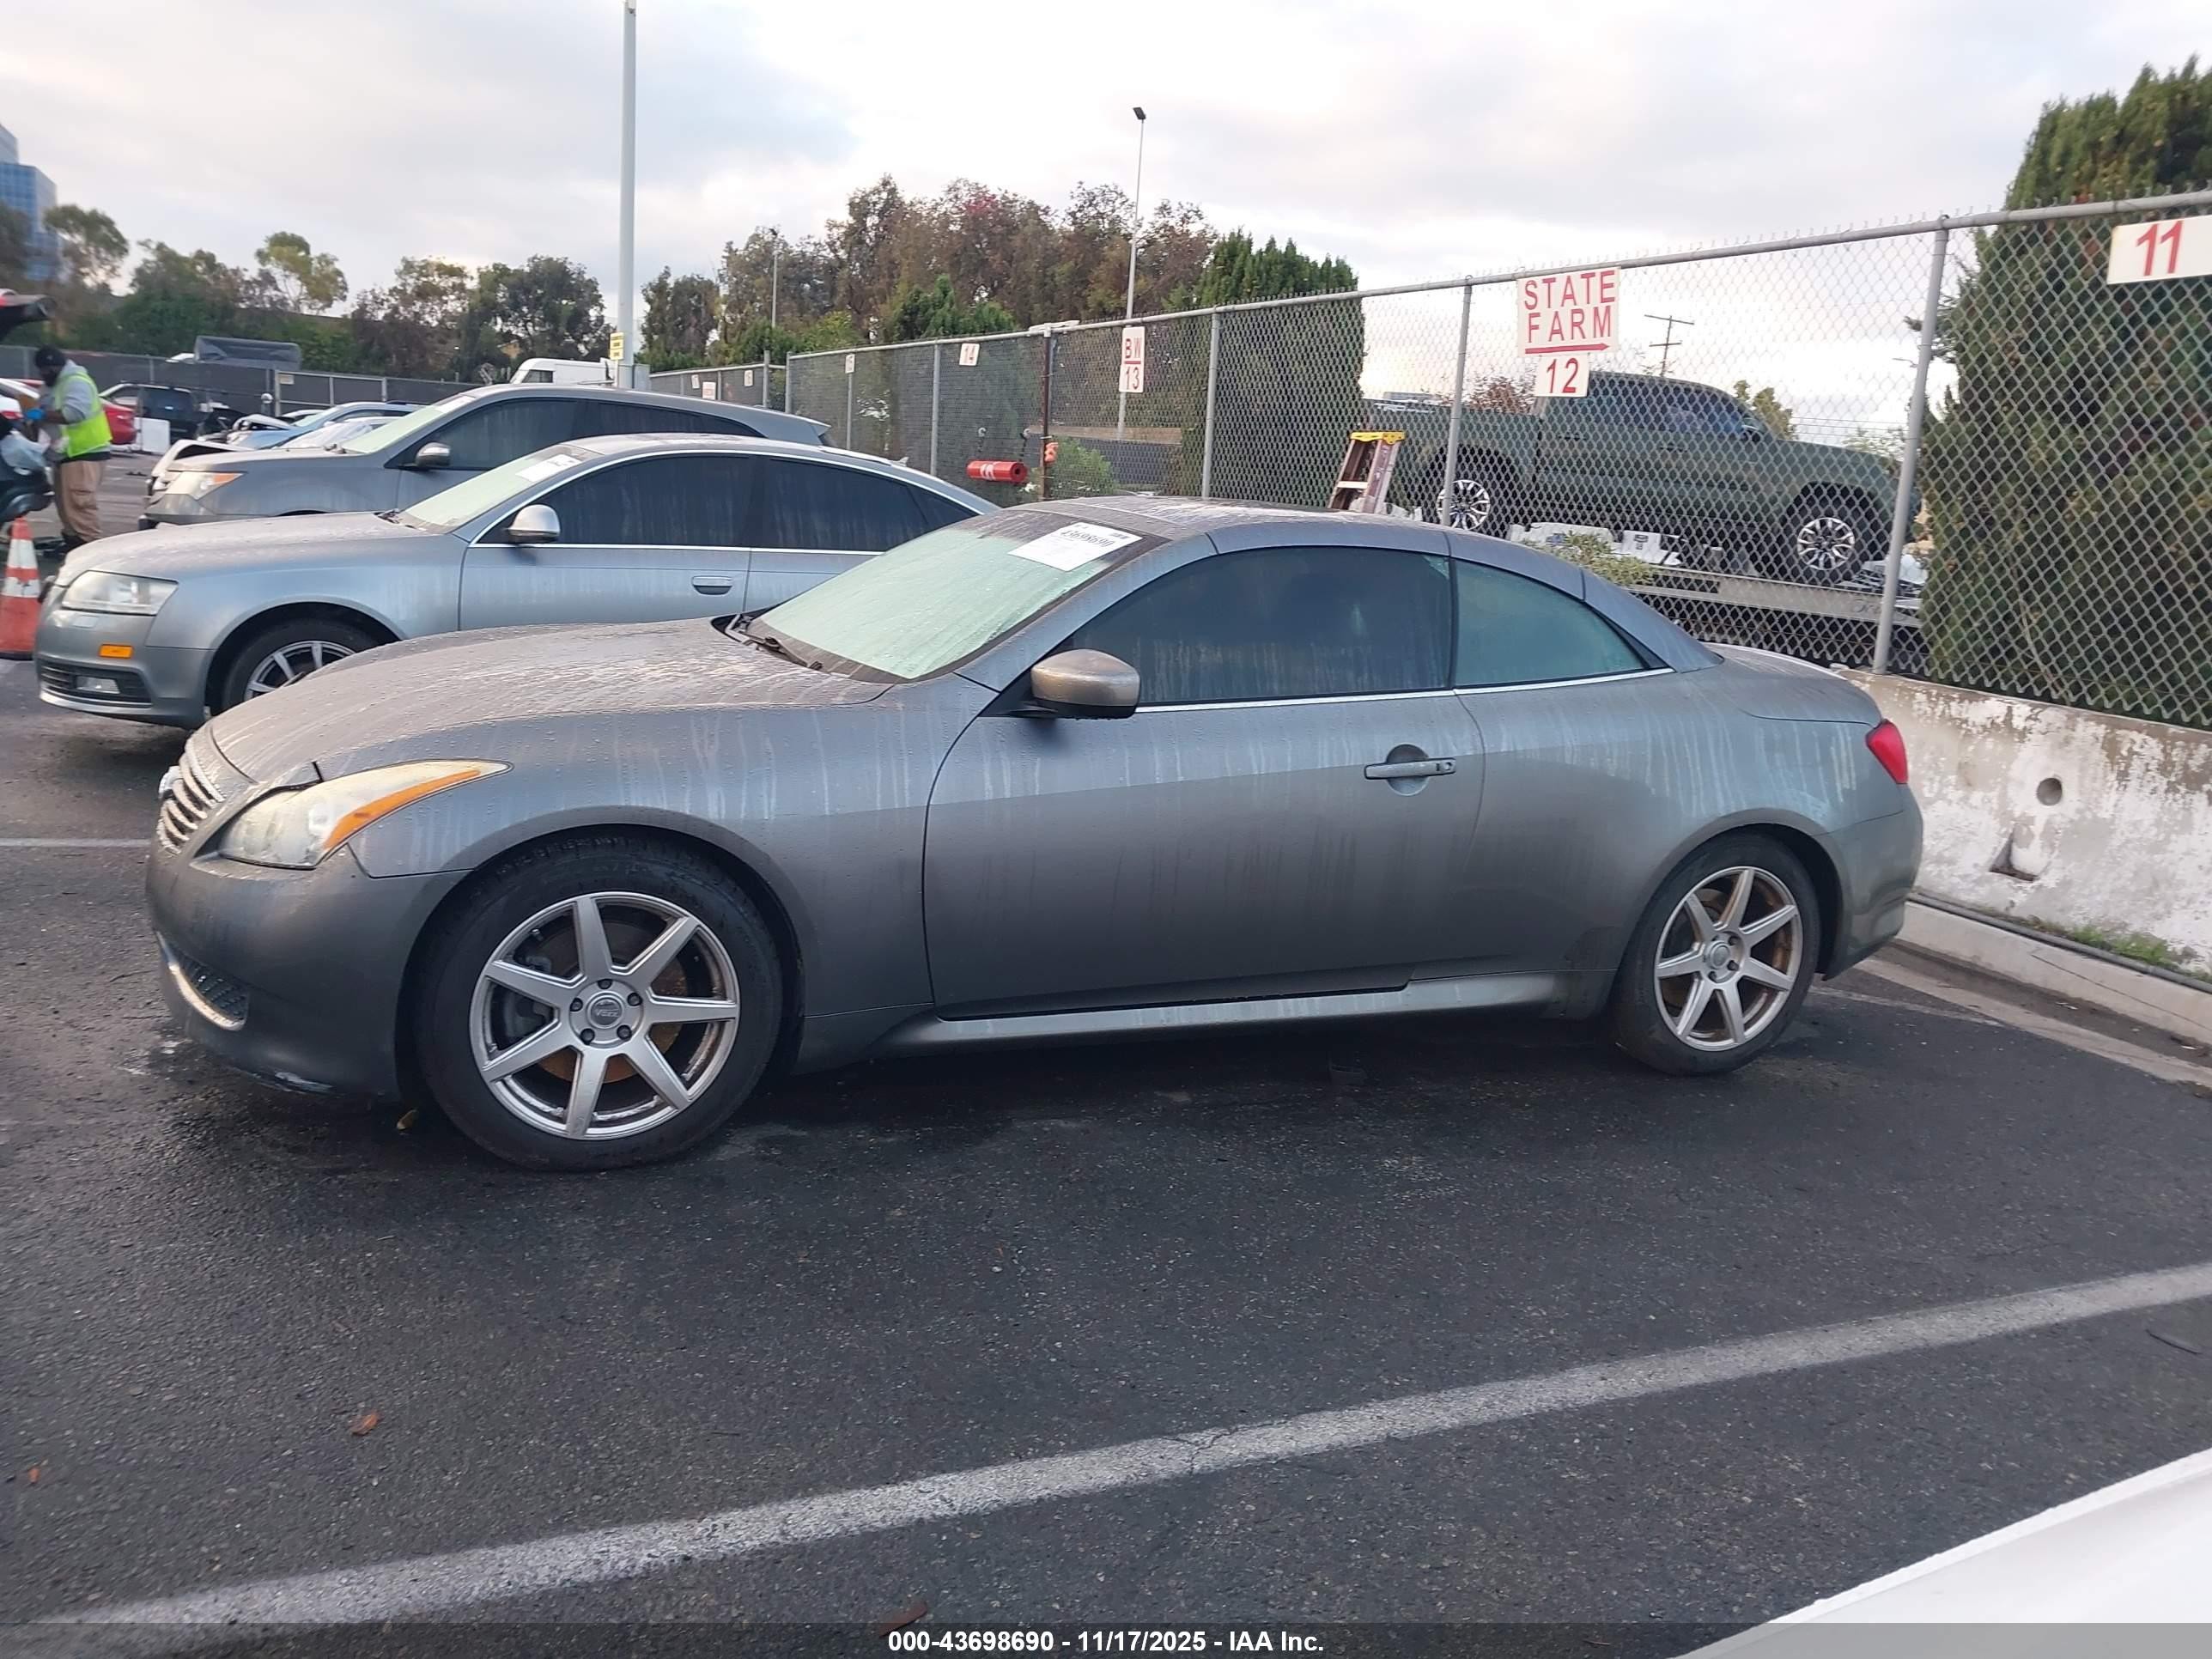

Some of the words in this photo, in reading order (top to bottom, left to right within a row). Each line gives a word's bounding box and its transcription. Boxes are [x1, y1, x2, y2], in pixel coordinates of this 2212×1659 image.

[2135, 220, 2183, 276] 11
[1524, 270, 1615, 310] STATE
[1528, 306, 1611, 343] FARM
[1126, 366, 1139, 390] 13
[1547, 357, 1578, 393] 12
